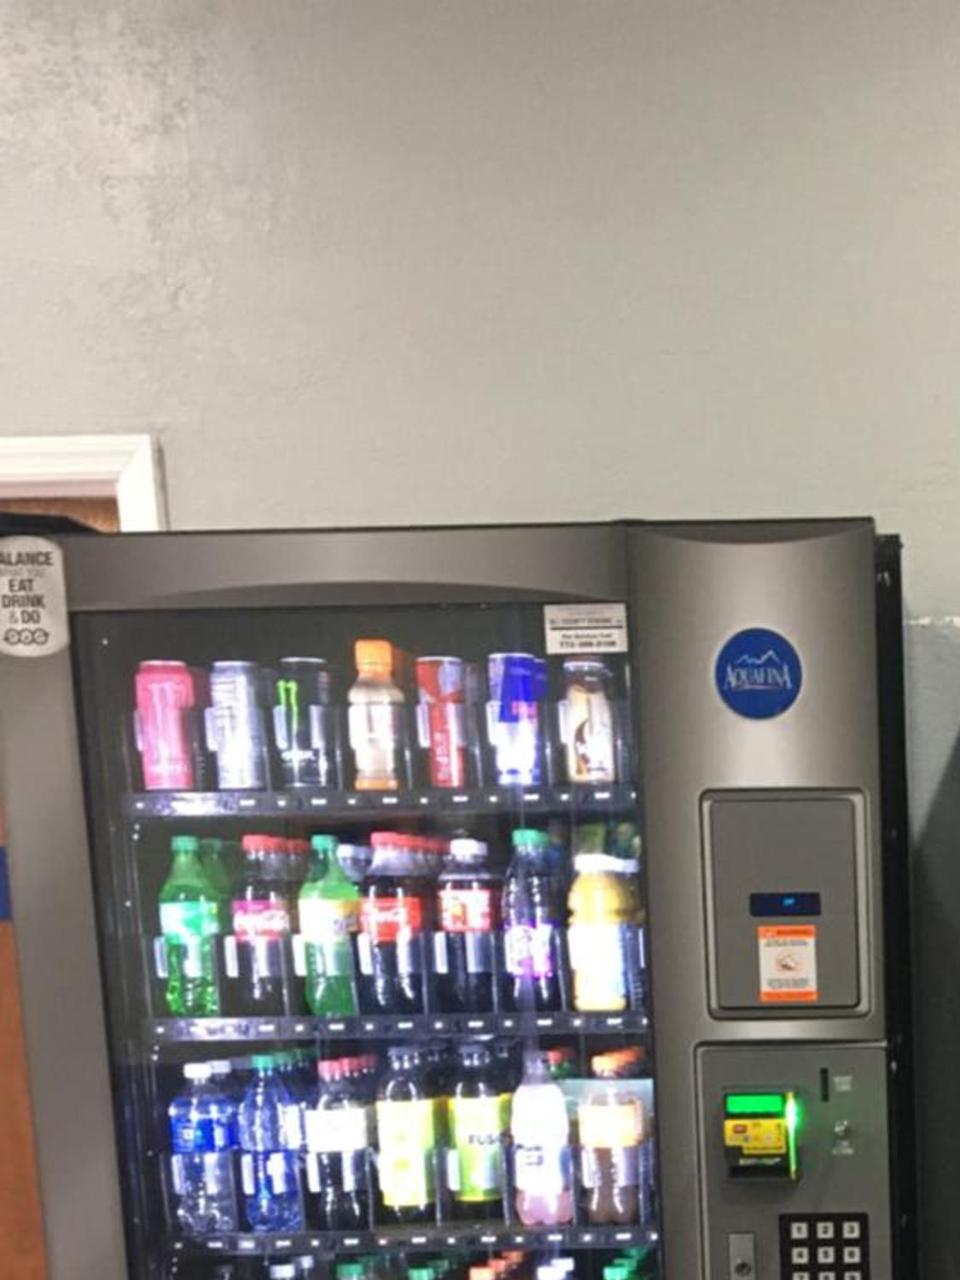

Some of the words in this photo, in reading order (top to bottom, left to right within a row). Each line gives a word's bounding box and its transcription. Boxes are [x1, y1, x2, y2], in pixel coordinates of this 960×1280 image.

[8, 579, 34, 592] EAT
[21, 610, 41, 624] DO
[724, 662, 792, 690] AQUAFINA
